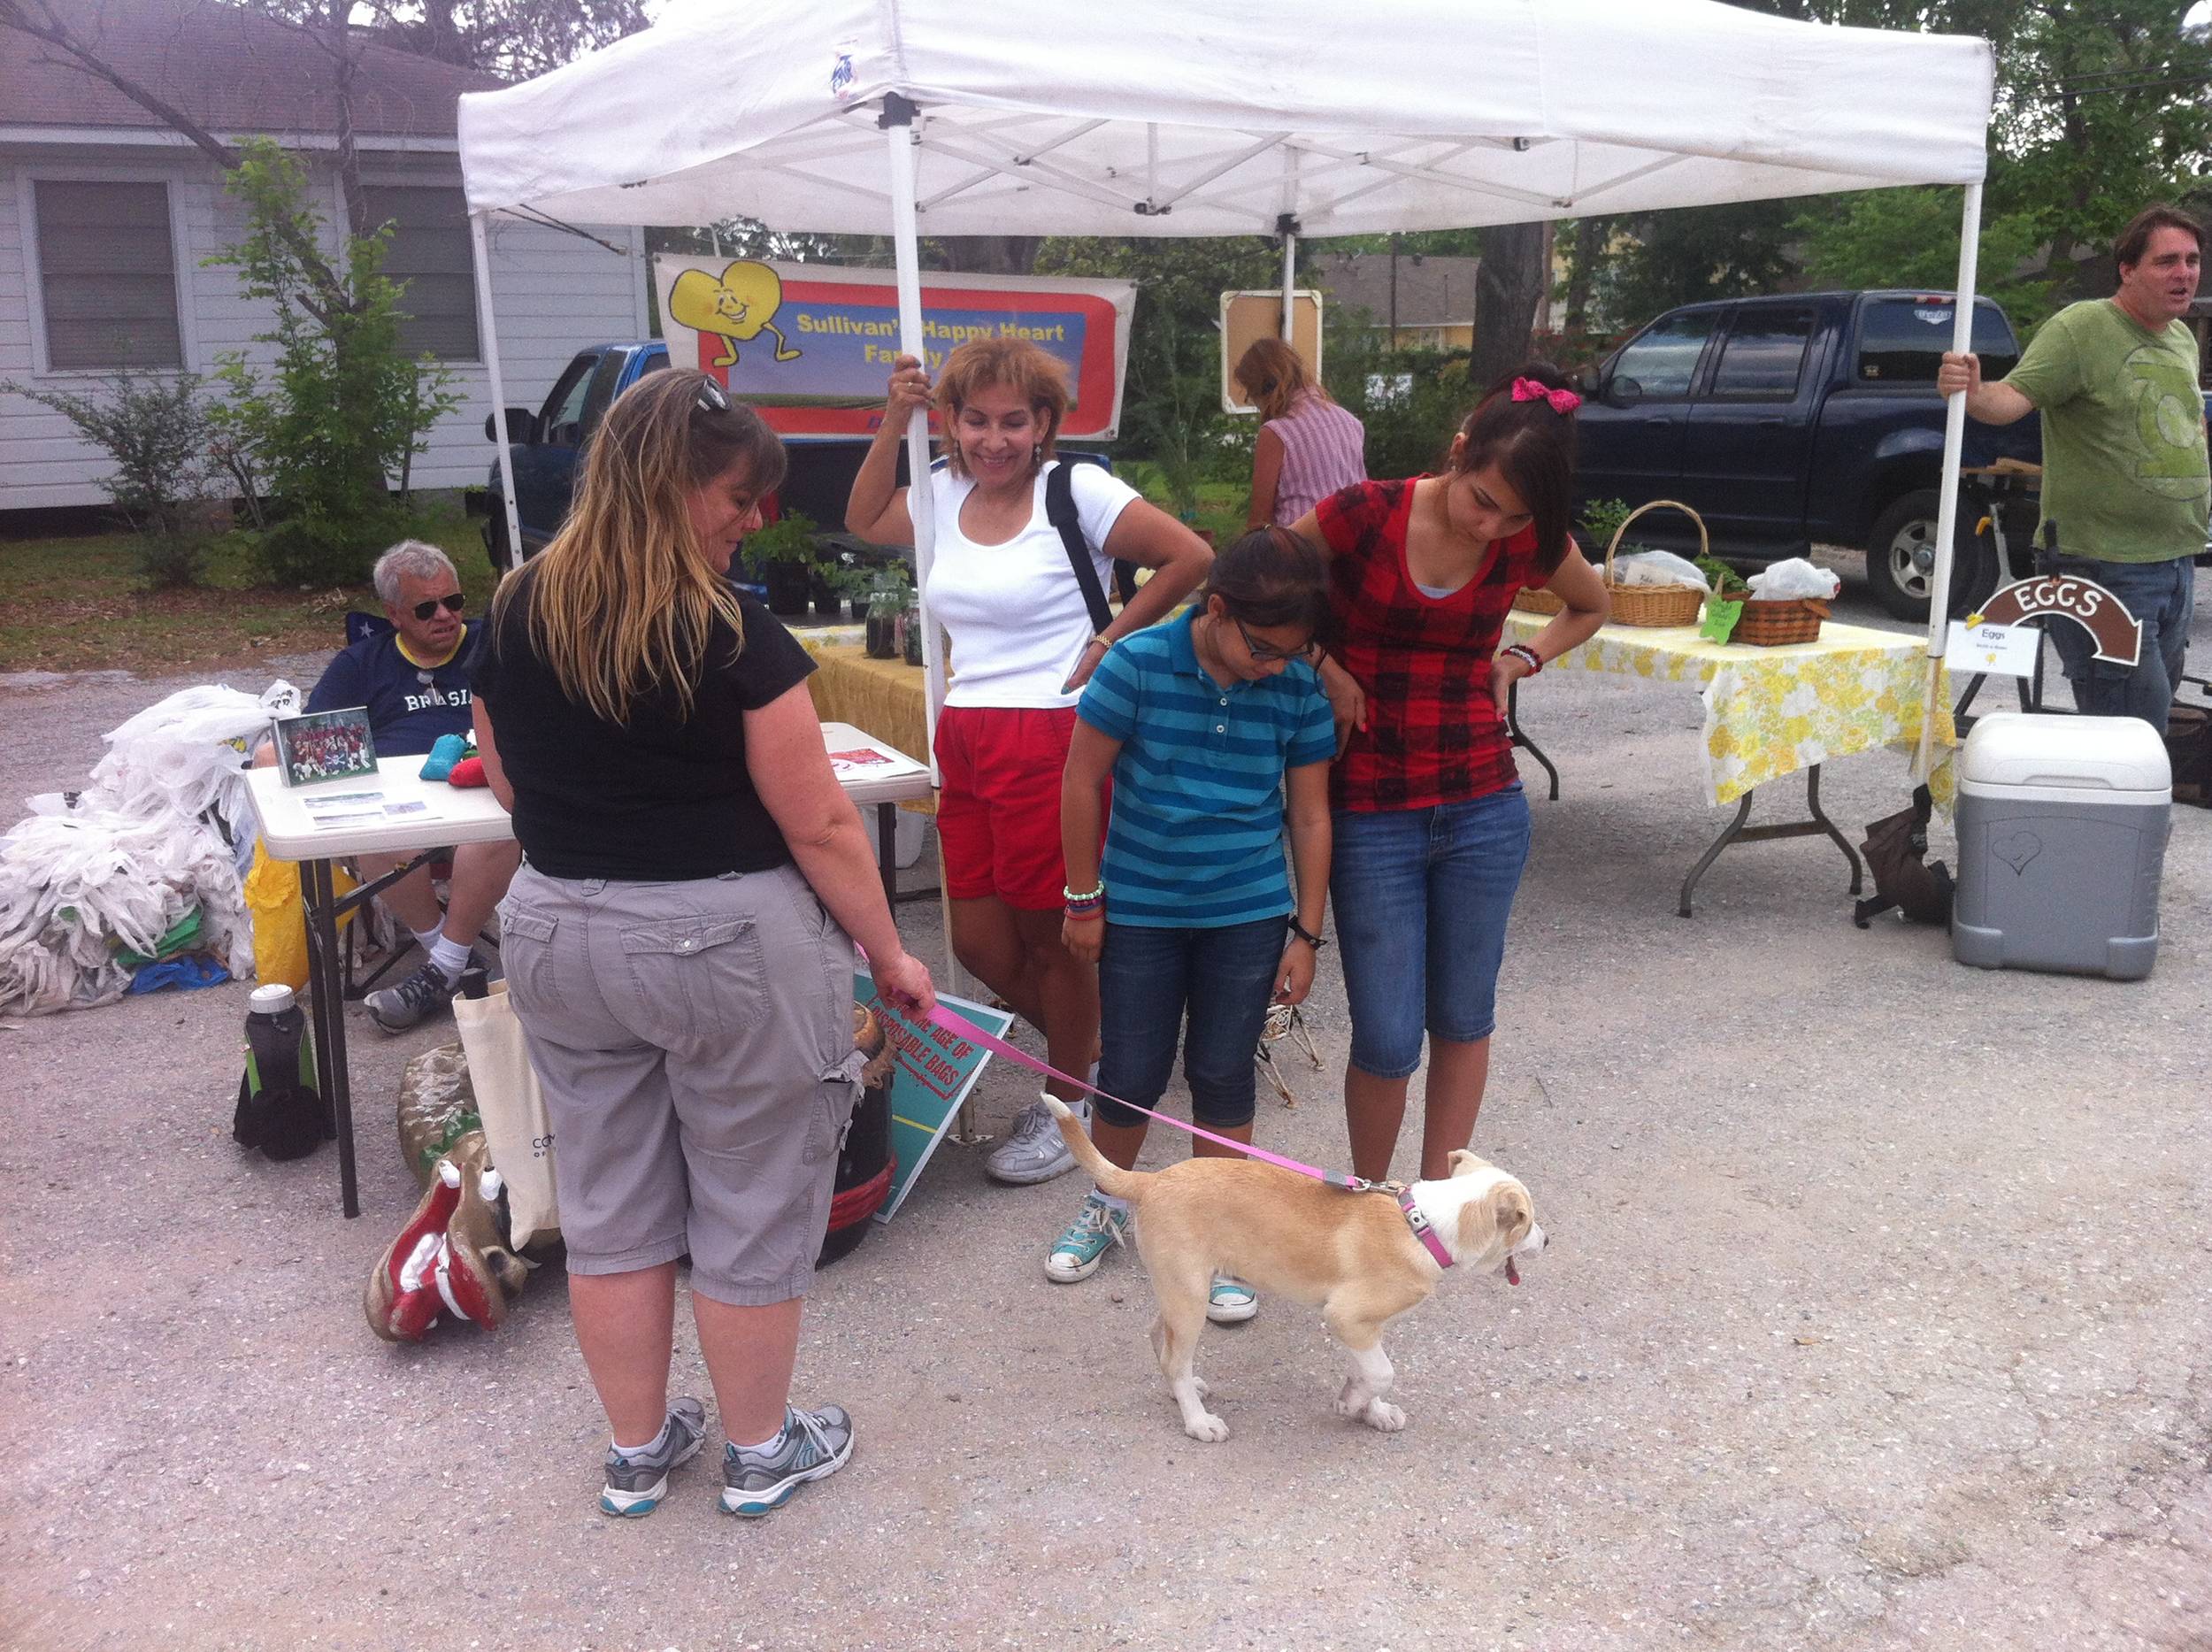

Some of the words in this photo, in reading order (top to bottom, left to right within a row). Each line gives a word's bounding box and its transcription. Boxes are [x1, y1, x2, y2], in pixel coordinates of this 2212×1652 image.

[796, 314, 900, 337] Sullivan'
[921, 320, 992, 343] Happy
[999, 321, 1065, 342] Heart
[864, 343, 942, 369] Faly
[2014, 583, 2103, 618] EGGS
[1982, 628, 2005, 640] Eggs
[404, 689, 472, 711] BRASI
[951, 1041, 974, 1060] OF
[924, 1053, 959, 1086] BAGS
